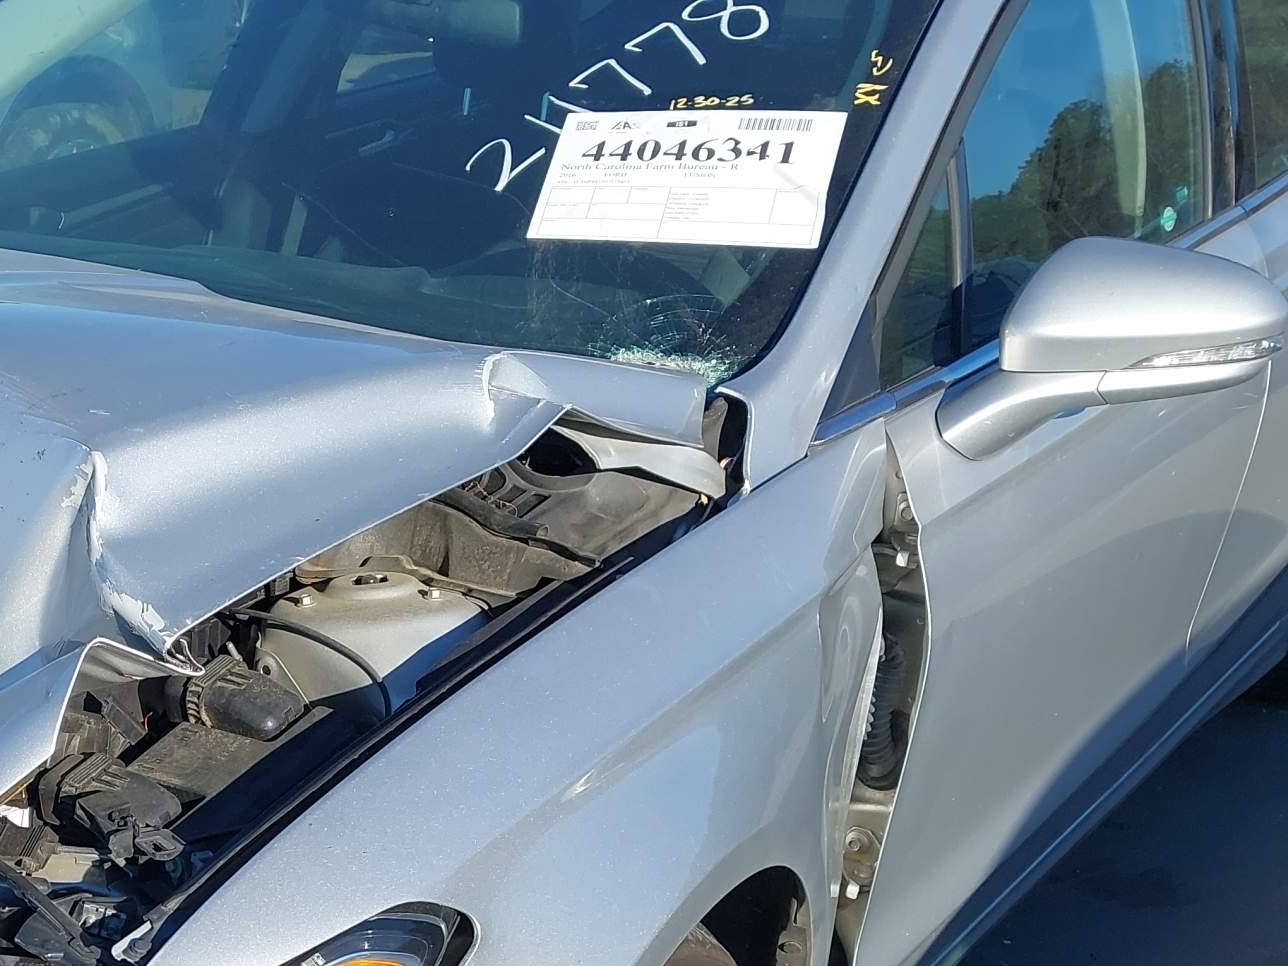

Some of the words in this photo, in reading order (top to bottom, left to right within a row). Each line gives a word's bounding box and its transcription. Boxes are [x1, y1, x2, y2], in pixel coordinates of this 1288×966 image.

[669, 94, 755, 110] 12-30-25
[581, 137, 795, 164] 44046341
[560, 163, 591, 171] North
[594, 163, 642, 171] Carolina
[645, 163, 675, 171] Farm
[678, 163, 719, 171] Bureau
